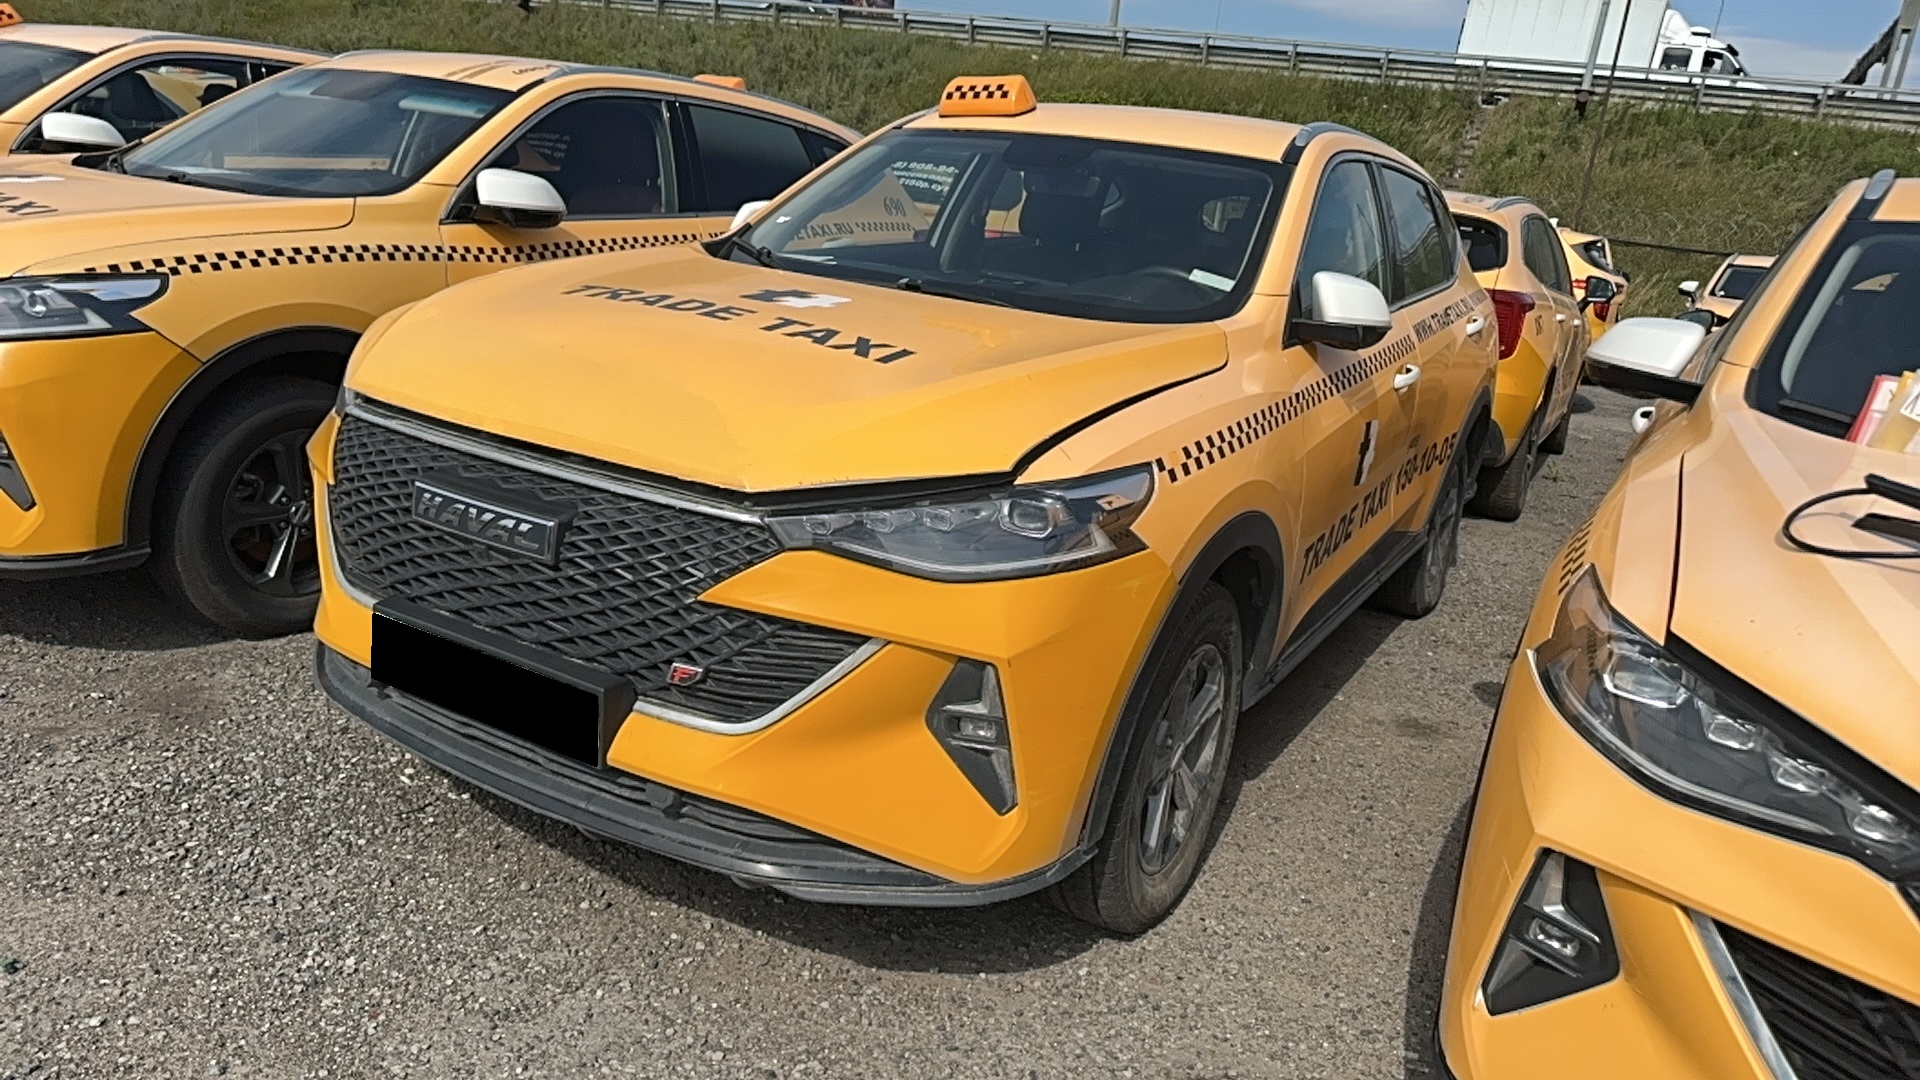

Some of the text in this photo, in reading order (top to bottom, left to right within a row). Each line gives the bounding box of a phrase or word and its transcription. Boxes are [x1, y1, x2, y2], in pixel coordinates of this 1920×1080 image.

[560, 285, 917, 364] TRADE TAXI
[418, 491, 540, 550] HAVAL
[1299, 502, 1359, 585] TRADE
[1359, 472, 1394, 530] TAXI
